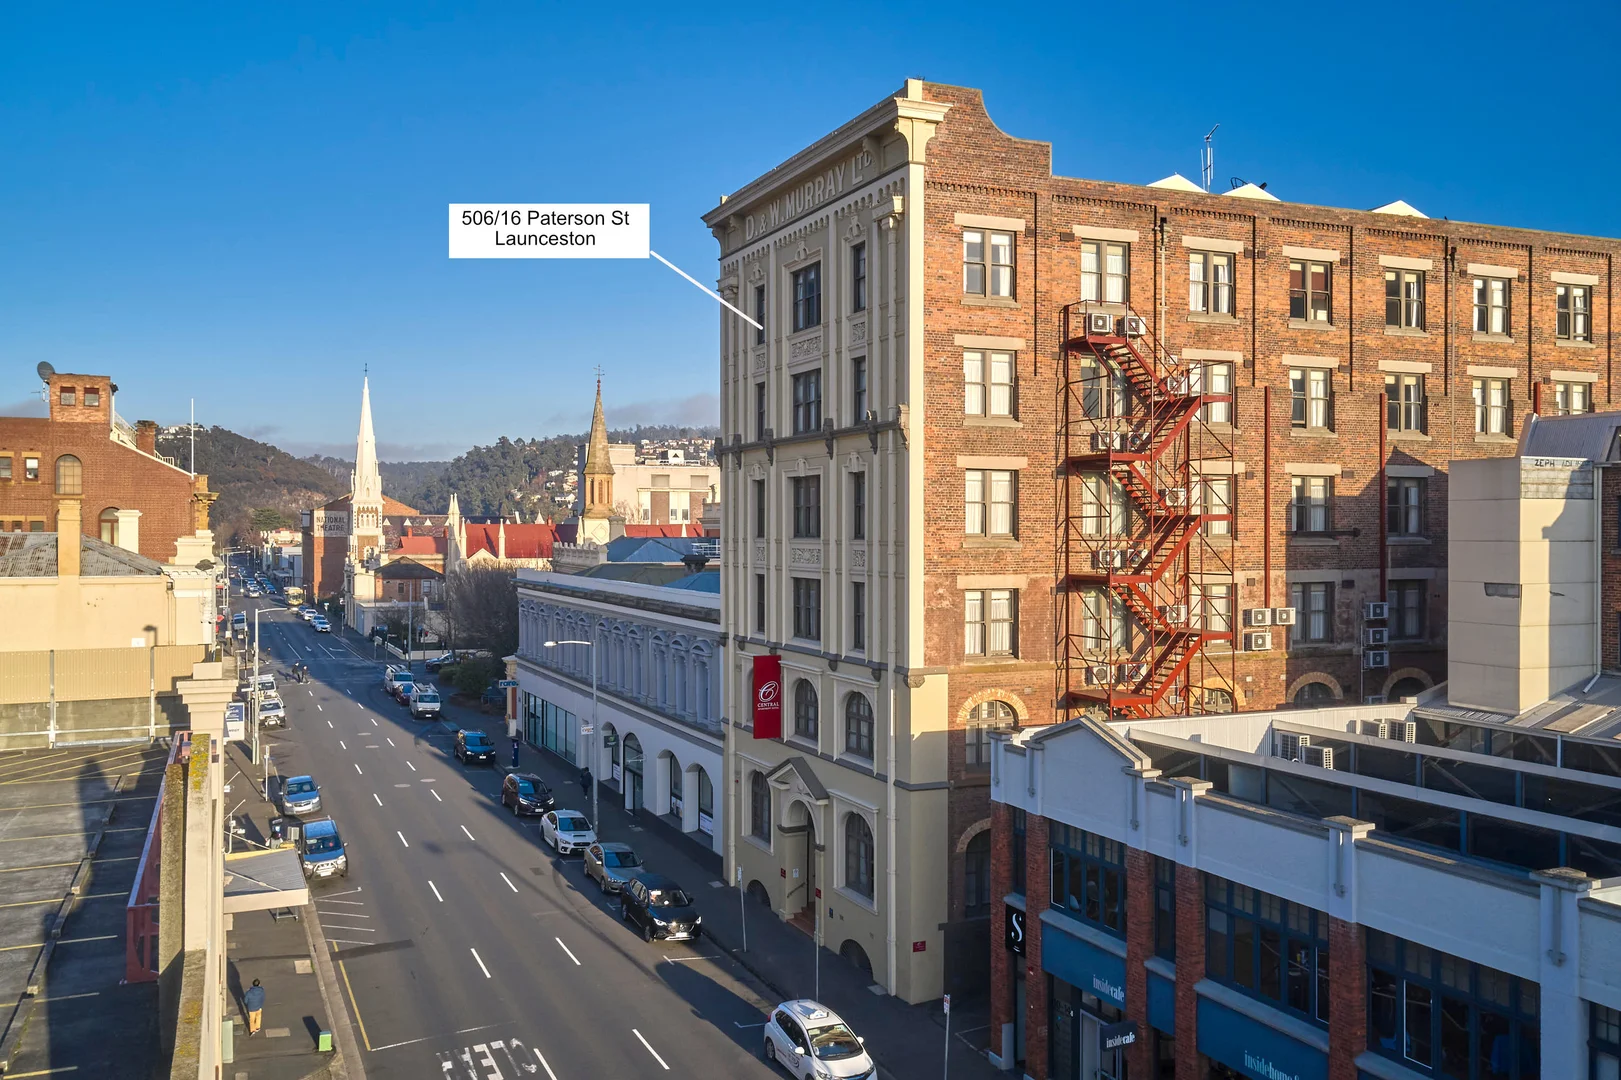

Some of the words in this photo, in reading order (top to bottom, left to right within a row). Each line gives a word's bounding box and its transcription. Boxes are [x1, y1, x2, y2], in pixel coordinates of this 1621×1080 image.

[759, 214, 767, 233] &
[785, 161, 847, 219] MURRAY
[1011, 913, 1023, 942] S
